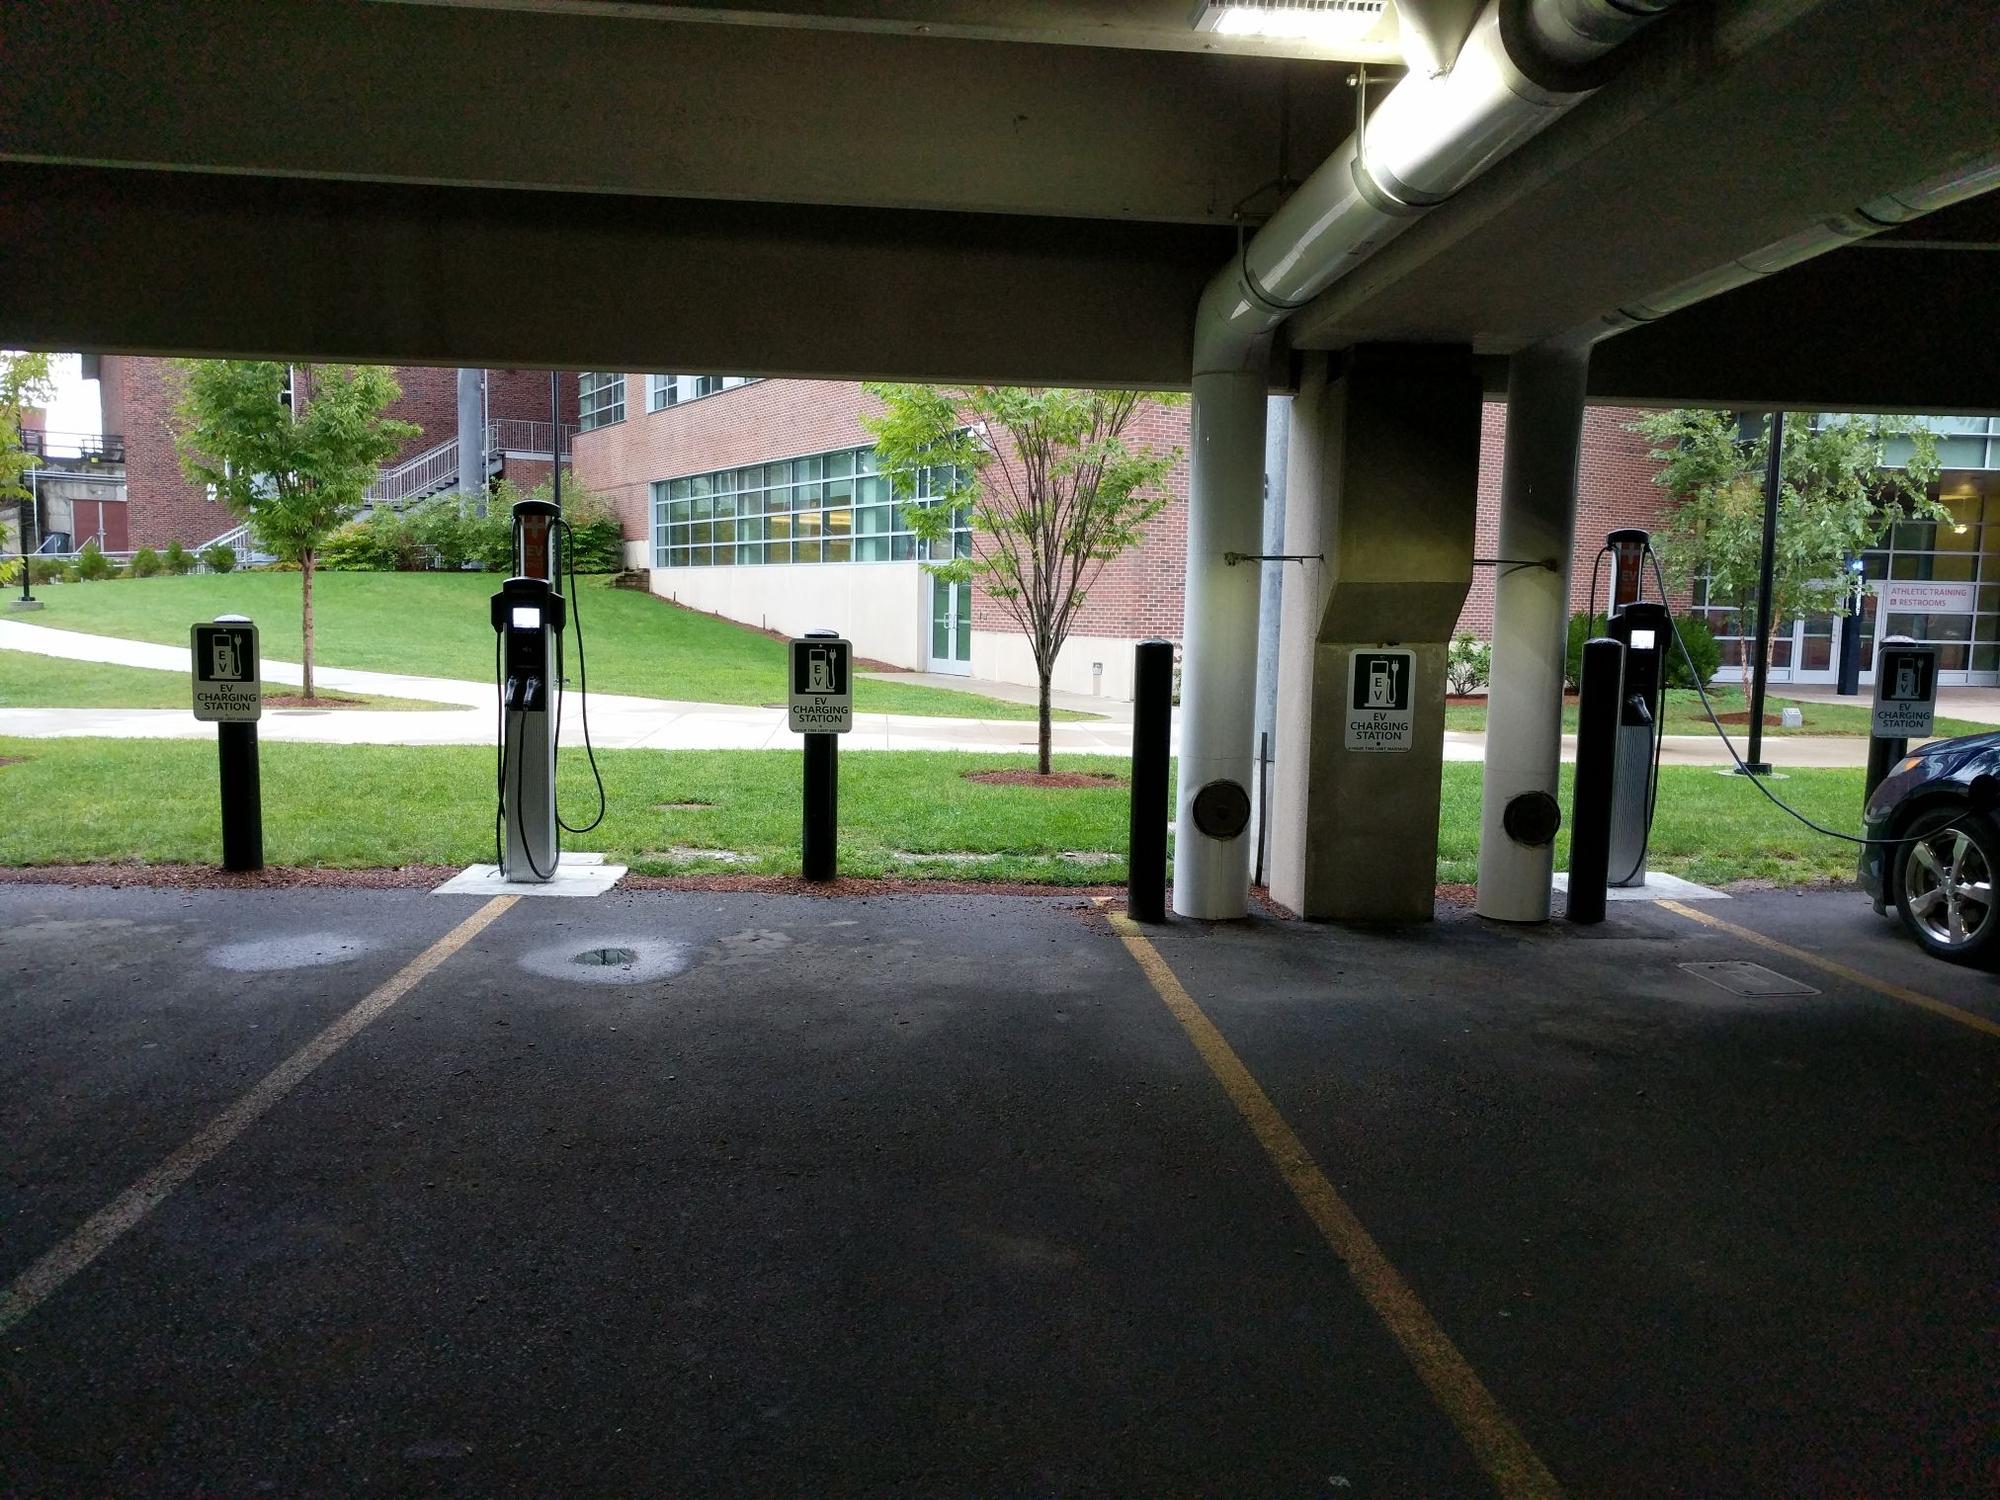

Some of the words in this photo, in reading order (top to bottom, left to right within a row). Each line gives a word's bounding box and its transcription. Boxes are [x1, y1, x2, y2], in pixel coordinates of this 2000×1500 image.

[1891, 587, 1927, 596] ATHLETIC
[1929, 588, 1967, 597] TRAINING
[1899, 598, 1946, 607] RESTROOMS
[220, 683, 234, 693] EV
[197, 692, 257, 703] CHARGING
[814, 697, 827, 705] EV
[203, 702, 251, 711] STATION
[793, 705, 849, 714] CHARGING
[1898, 703, 1911, 711] EV
[798, 714, 842, 723] STATION
[1373, 712, 1387, 721] EV
[1878, 711, 1930, 720] CHARGING
[1350, 721, 1409, 731] CHARGING
[1882, 720, 1924, 728] STATION
[1355, 731, 1402, 740] STATION
